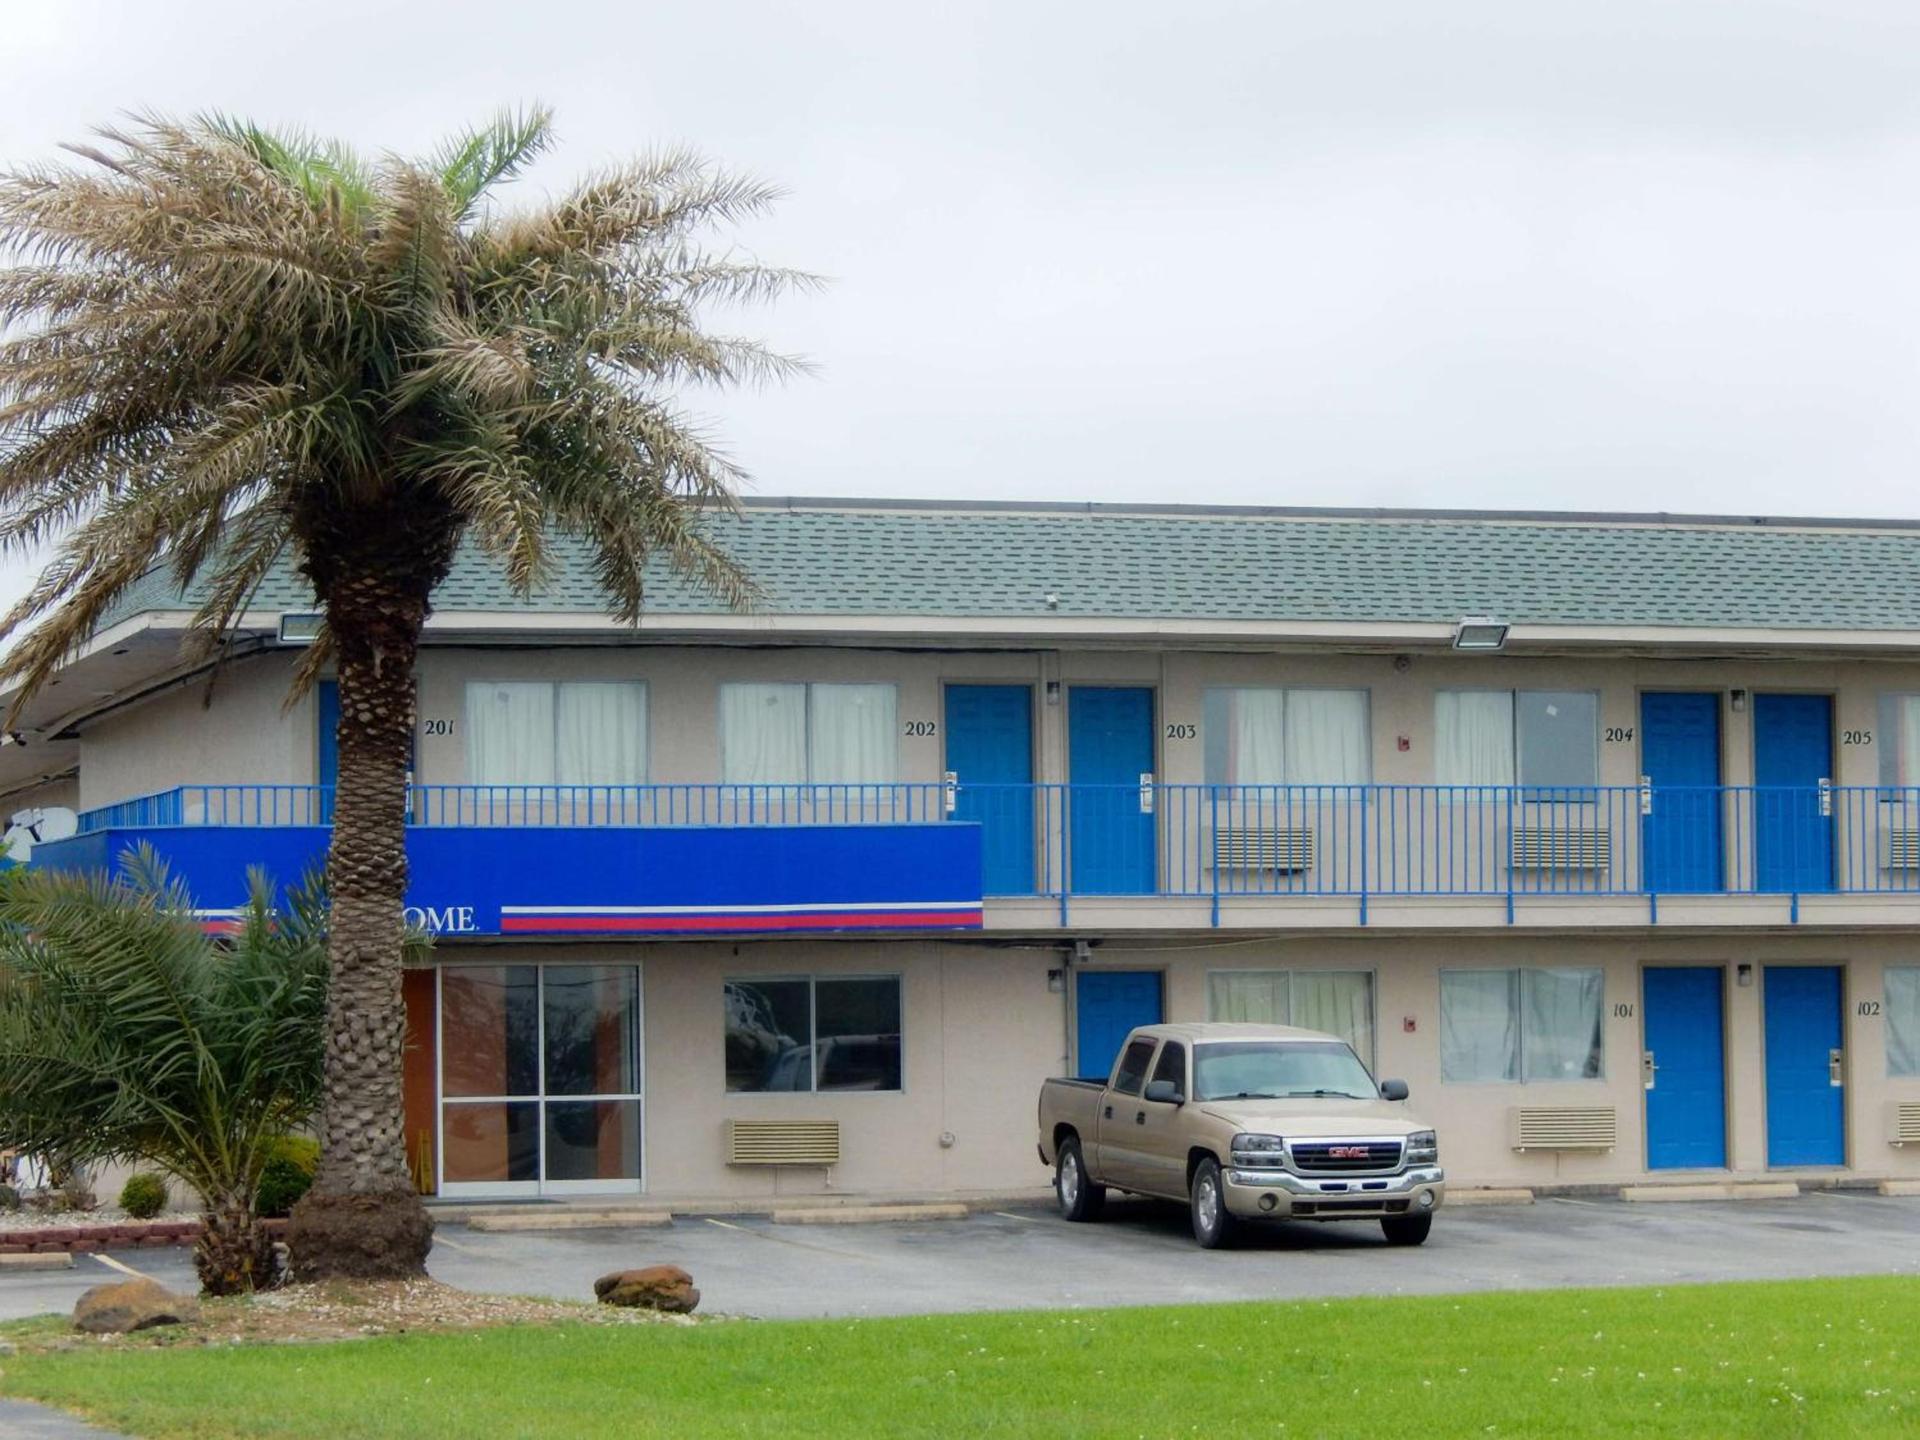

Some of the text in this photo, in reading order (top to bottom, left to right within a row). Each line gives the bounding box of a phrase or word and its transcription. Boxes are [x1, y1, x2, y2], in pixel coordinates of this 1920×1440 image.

[425, 719, 455, 736] 201
[905, 721, 936, 737] 202
[1166, 724, 1196, 739] 203
[1605, 727, 1634, 742] 204
[1843, 730, 1872, 745] 205
[1613, 1003, 1634, 1018] 101
[1857, 1001, 1881, 1016] 102
[1328, 1147, 1370, 1158] GMC
